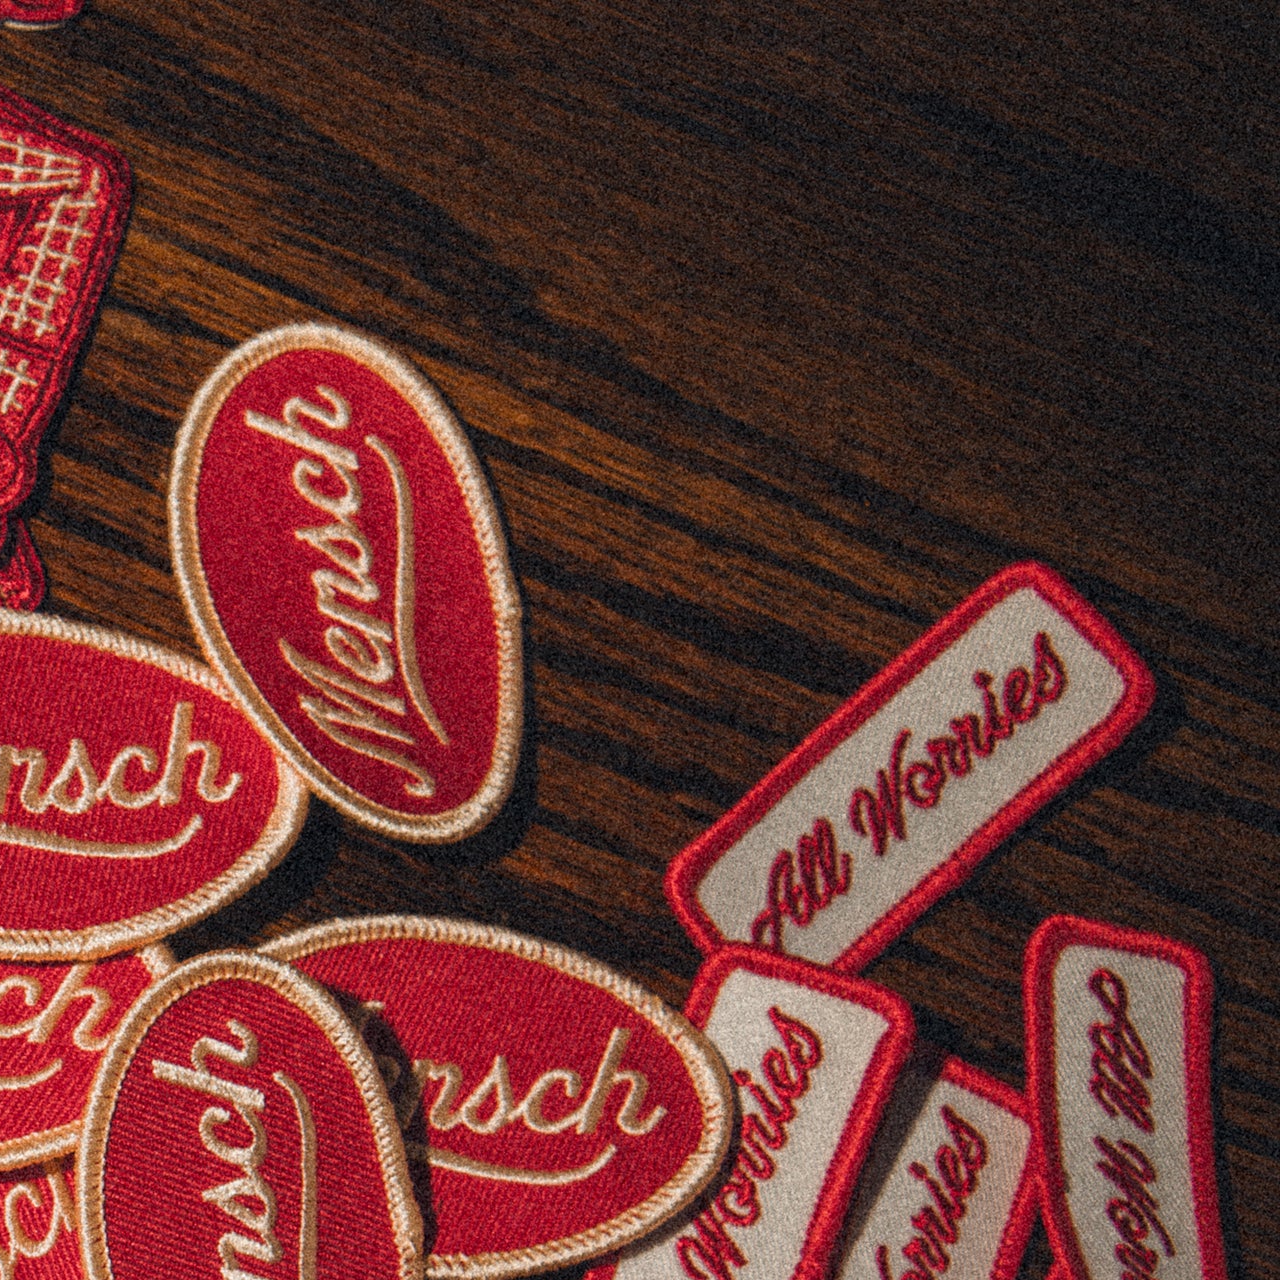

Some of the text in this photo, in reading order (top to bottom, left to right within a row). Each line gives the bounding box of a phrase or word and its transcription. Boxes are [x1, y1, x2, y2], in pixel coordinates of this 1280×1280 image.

[245, 385, 434, 797] Mensch
[752, 631, 1069, 953] All Worries
[1088, 966, 1155, 1135] All
